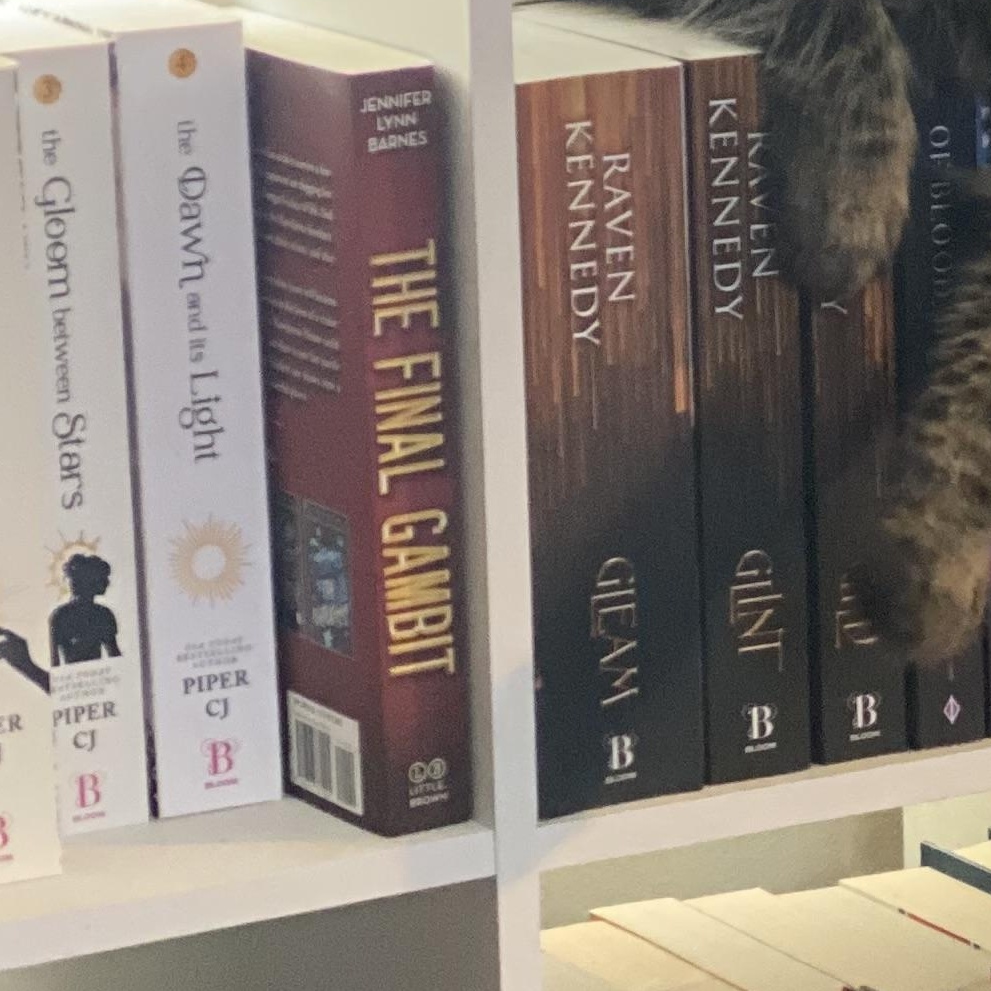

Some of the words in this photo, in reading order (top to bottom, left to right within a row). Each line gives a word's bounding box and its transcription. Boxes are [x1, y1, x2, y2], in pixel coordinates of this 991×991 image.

[360, 90, 432, 113] JENNIFER
[177, 120, 198, 156] the
[376, 112, 418, 131] LYNN
[42, 130, 62, 166] the
[367, 130, 428, 153] BARNES
[177, 165, 212, 290] Dawn
[602, 153, 636, 303] RAVEN
[708, 98, 744, 320] KENNEDY
[34, 176, 75, 299] Gloom
[565, 121, 601, 347] KENNEDY
[369, 237, 440, 337] THE
[185, 291, 202, 335] and
[53, 308, 72, 403] between
[188, 336, 205, 363] its
[178, 370, 226, 464] Light
[373, 351, 446, 497] FINAL
[52, 412, 86, 510] Stars
[380, 509, 457, 678] GAMBIT
[182, 669, 250, 696] PIPER
[52, 701, 117, 728] PIPER
[205, 697, 231, 721] CJ
[745, 703, 776, 740] B
[850, 692, 880, 729] B
[73, 729, 98, 752] CJ
[206, 738, 236, 776] B
[605, 733, 637, 771] B
[75, 773, 102, 808] B
